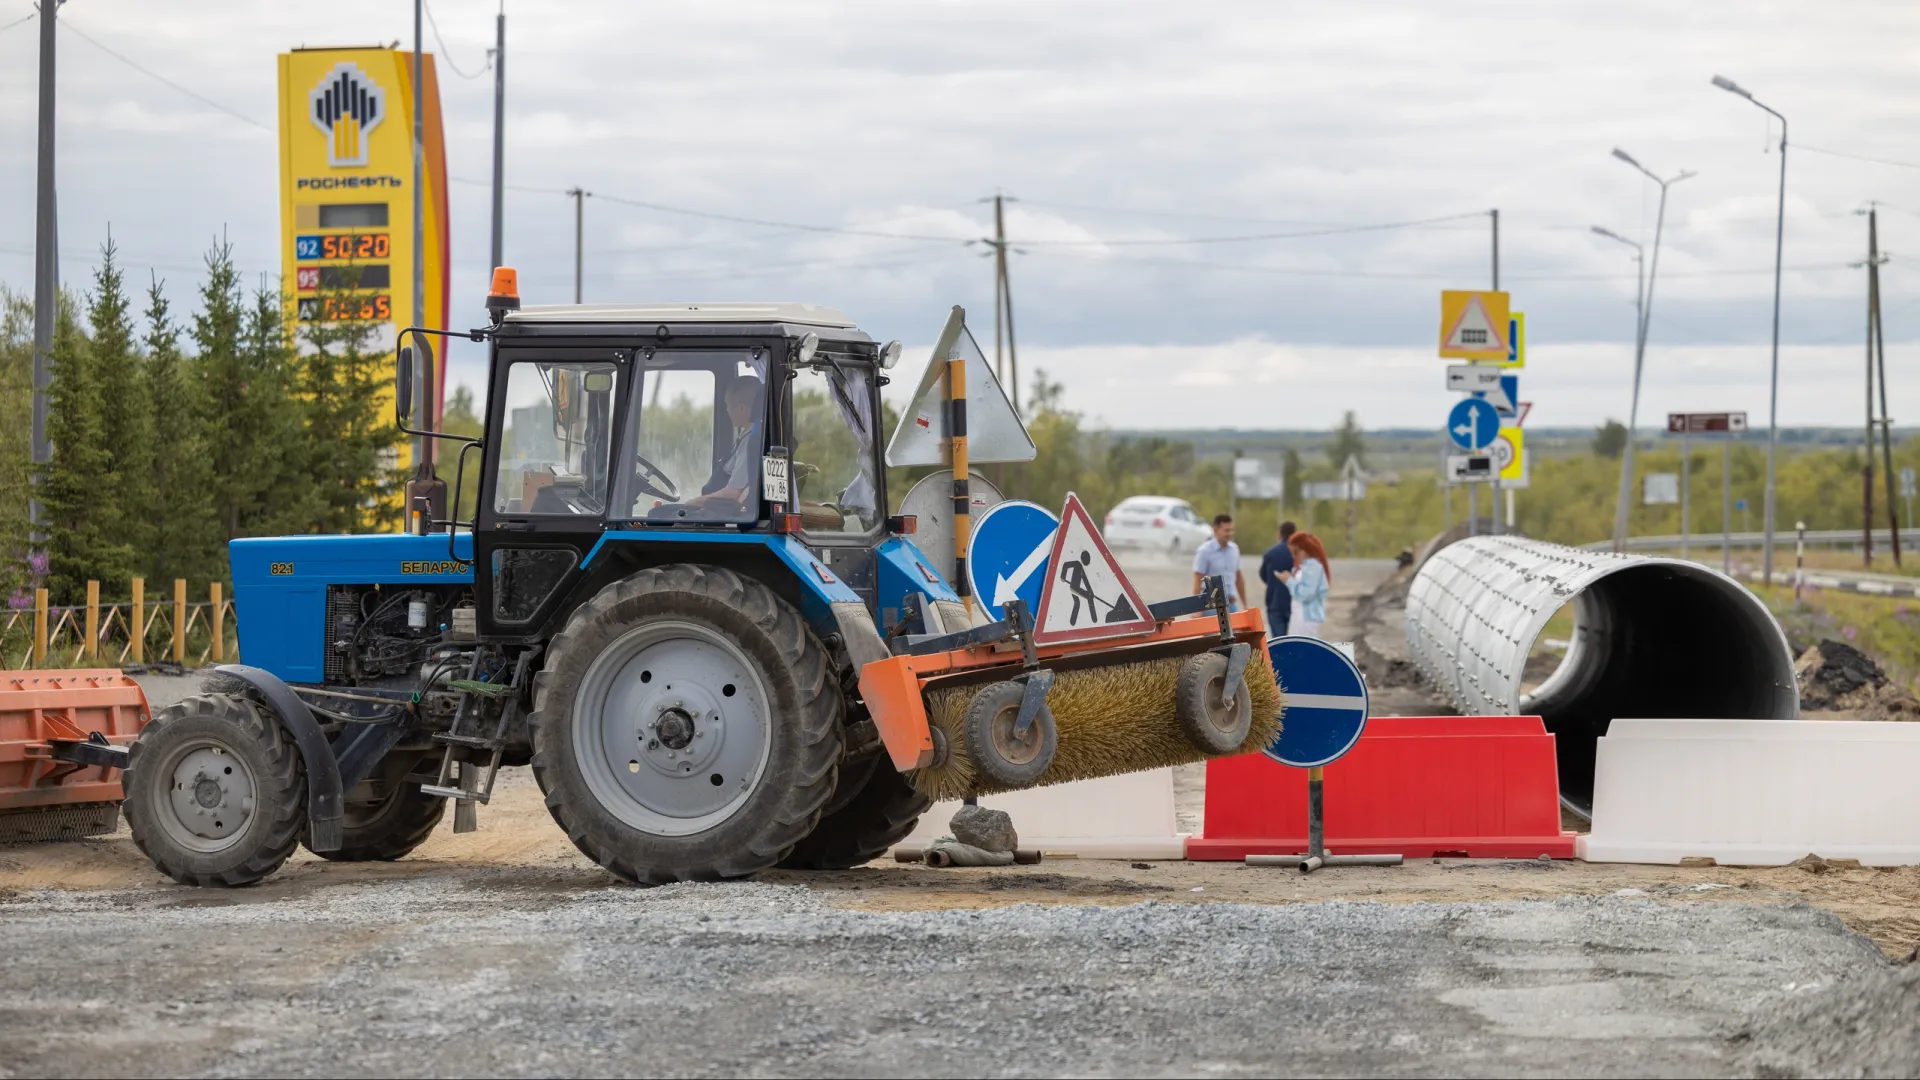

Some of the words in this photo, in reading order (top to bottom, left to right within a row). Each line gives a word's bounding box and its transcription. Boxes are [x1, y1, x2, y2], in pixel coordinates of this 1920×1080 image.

[297, 176, 402, 189] РОСНЕФТЬ
[298, 240, 318, 256] 92
[298, 269, 319, 288] 95
[767, 460, 785, 478] 0222
[779, 481, 787, 495] 86
[401, 561, 468, 575] БЕЛАРУС
